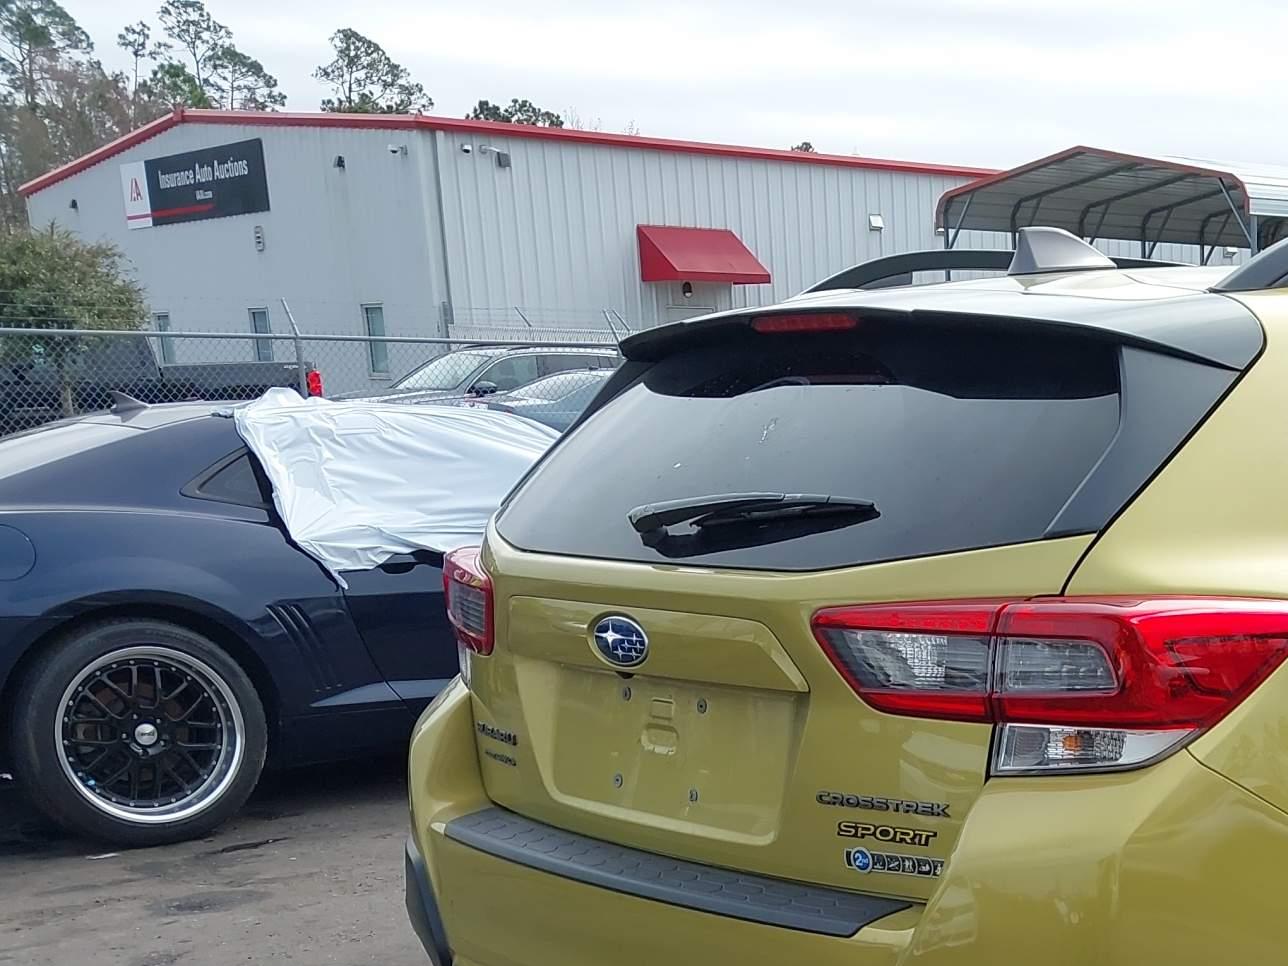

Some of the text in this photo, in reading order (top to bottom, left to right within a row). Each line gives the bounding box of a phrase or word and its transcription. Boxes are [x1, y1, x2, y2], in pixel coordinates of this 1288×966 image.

[158, 156, 248, 189] Insurance Auto Auctions
[816, 790, 951, 818] CROSSTREK
[837, 820, 937, 847] SPORT
